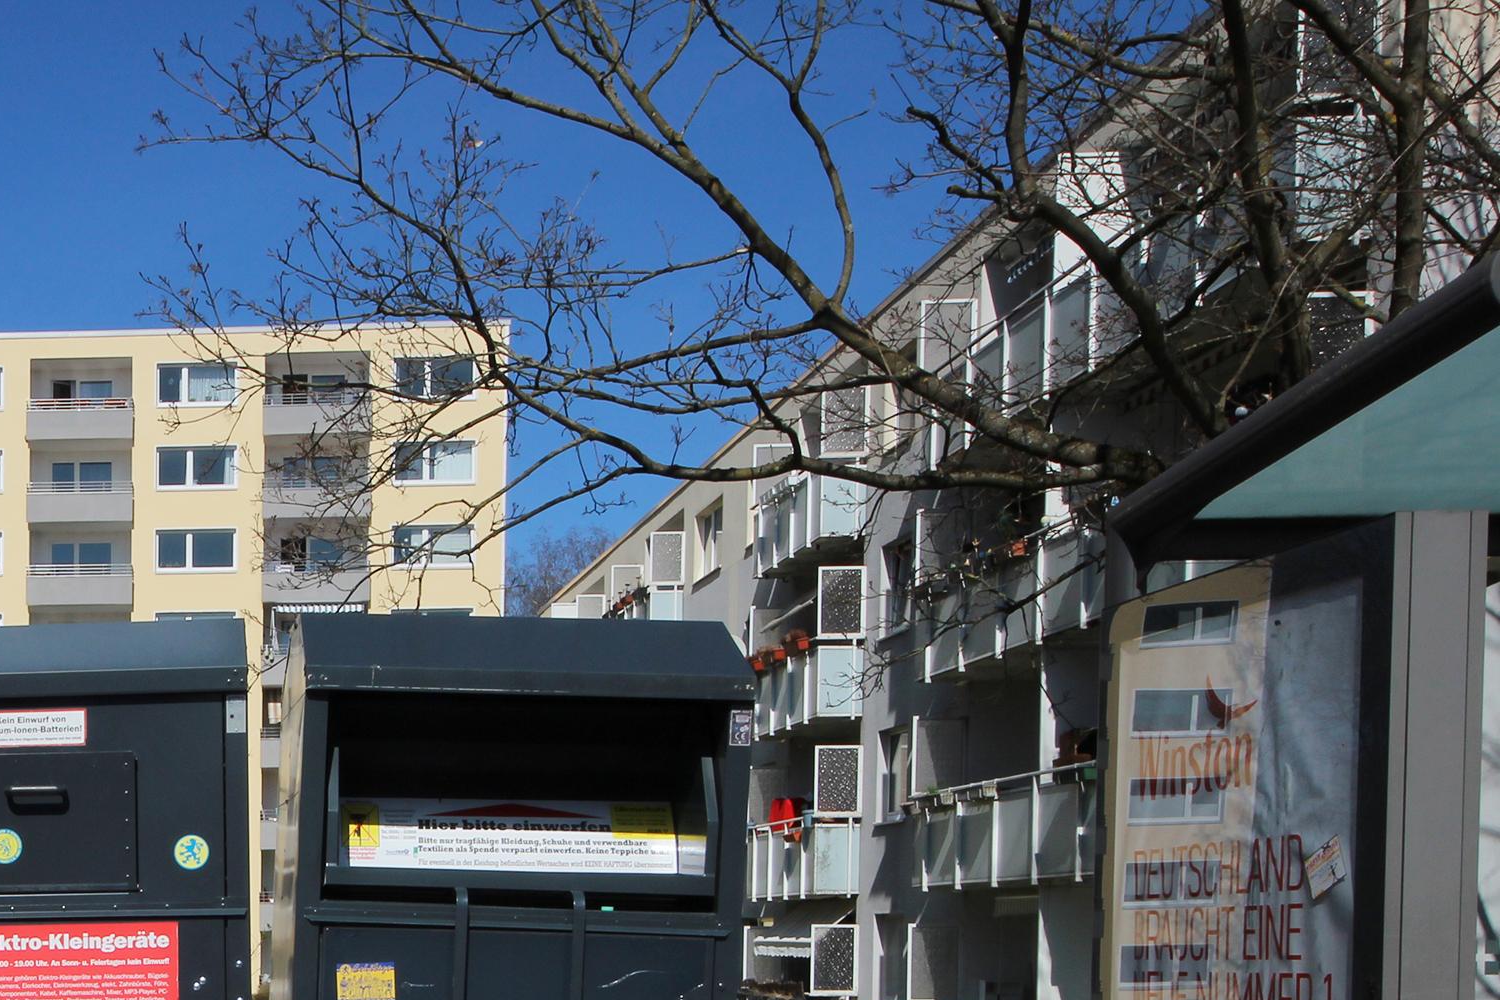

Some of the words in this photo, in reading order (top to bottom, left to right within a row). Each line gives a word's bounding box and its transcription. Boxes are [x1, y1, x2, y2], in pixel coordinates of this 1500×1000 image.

[17, 716, 49, 724] Einwurf
[1138, 729, 1253, 801] Winston
[418, 819, 457, 830] Hier
[462, 819, 508, 830] bitte
[512, 820, 611, 832] einwerfen
[455, 837, 499, 846] tragfähige
[501, 838, 541, 846] Kleidung,
[469, 846, 499, 854] Spende
[501, 846, 538, 854] verpackt
[611, 847, 649, 856] Teppiche
[1133, 834, 1304, 900] DEUTSCHLAND
[1133, 905, 1235, 961] BRAUCHT
[1242, 903, 1303, 960] EINE
